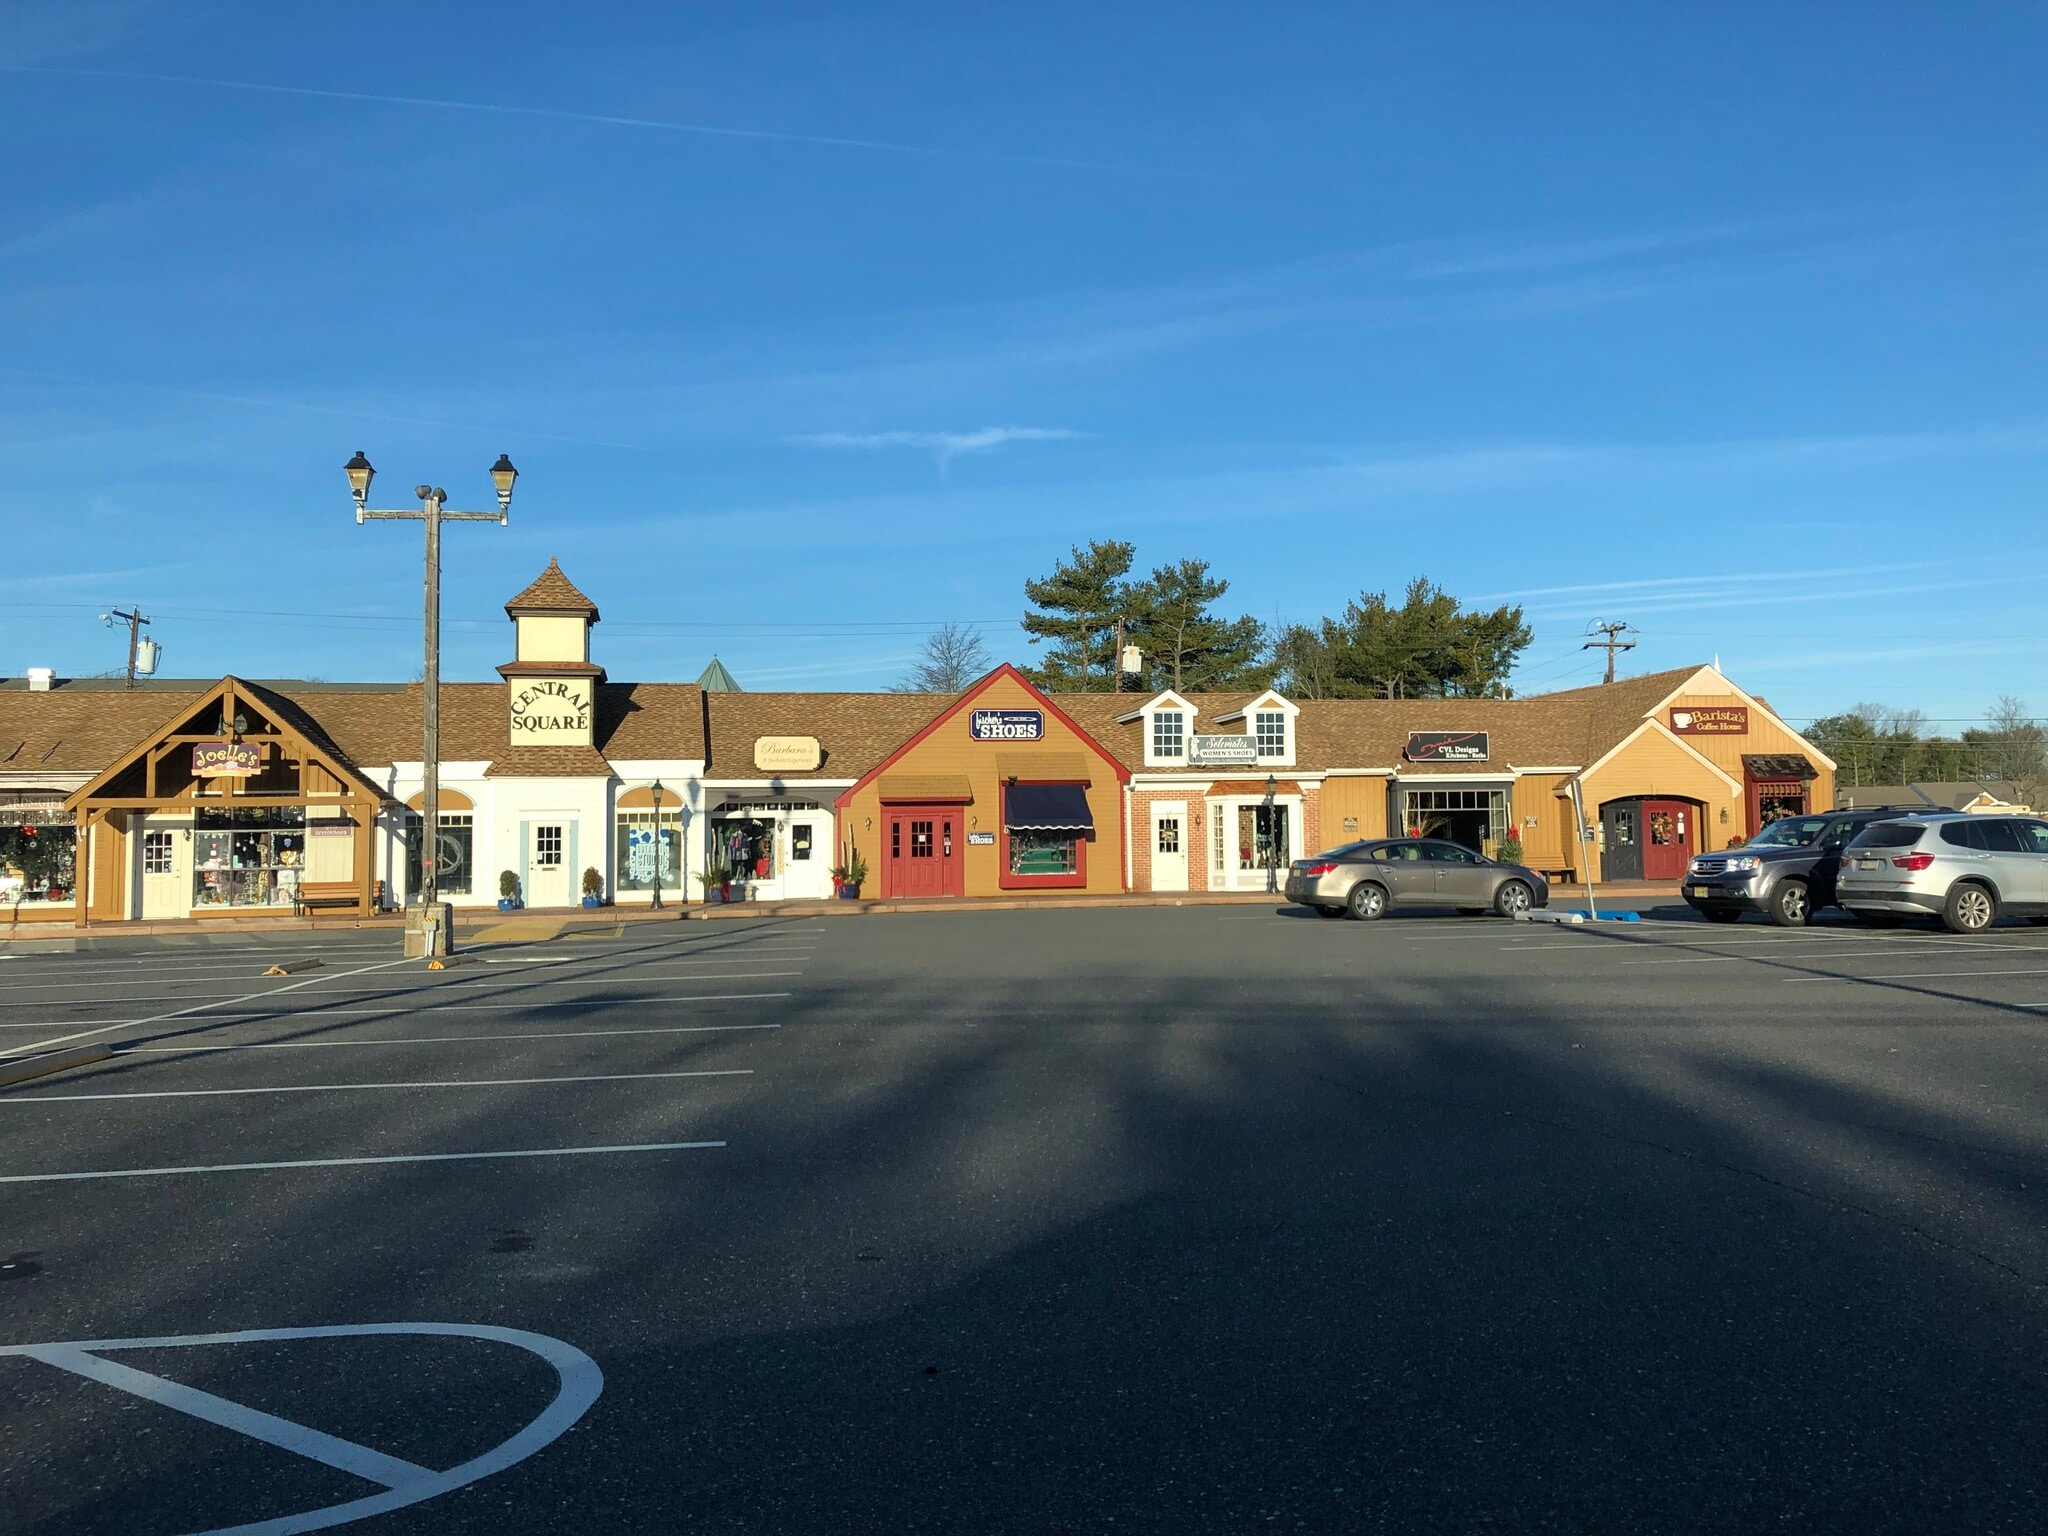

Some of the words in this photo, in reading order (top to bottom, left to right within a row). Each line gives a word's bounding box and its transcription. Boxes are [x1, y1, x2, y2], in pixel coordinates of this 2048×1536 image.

[511, 681, 591, 716] CENTRAL
[1691, 710, 1746, 723] Barista's
[512, 715, 588, 732] SQUARE
[1696, 722, 1719, 731] Coffee
[1720, 722, 1742, 731] House
[980, 724, 1038, 738] SHOES
[761, 741, 814, 754] Barbara's
[1438, 746, 1454, 754] CVL
[1455, 745, 1479, 754] Designs
[196, 744, 257, 767] Joelle's
[638, 854, 663, 867] STUDO
